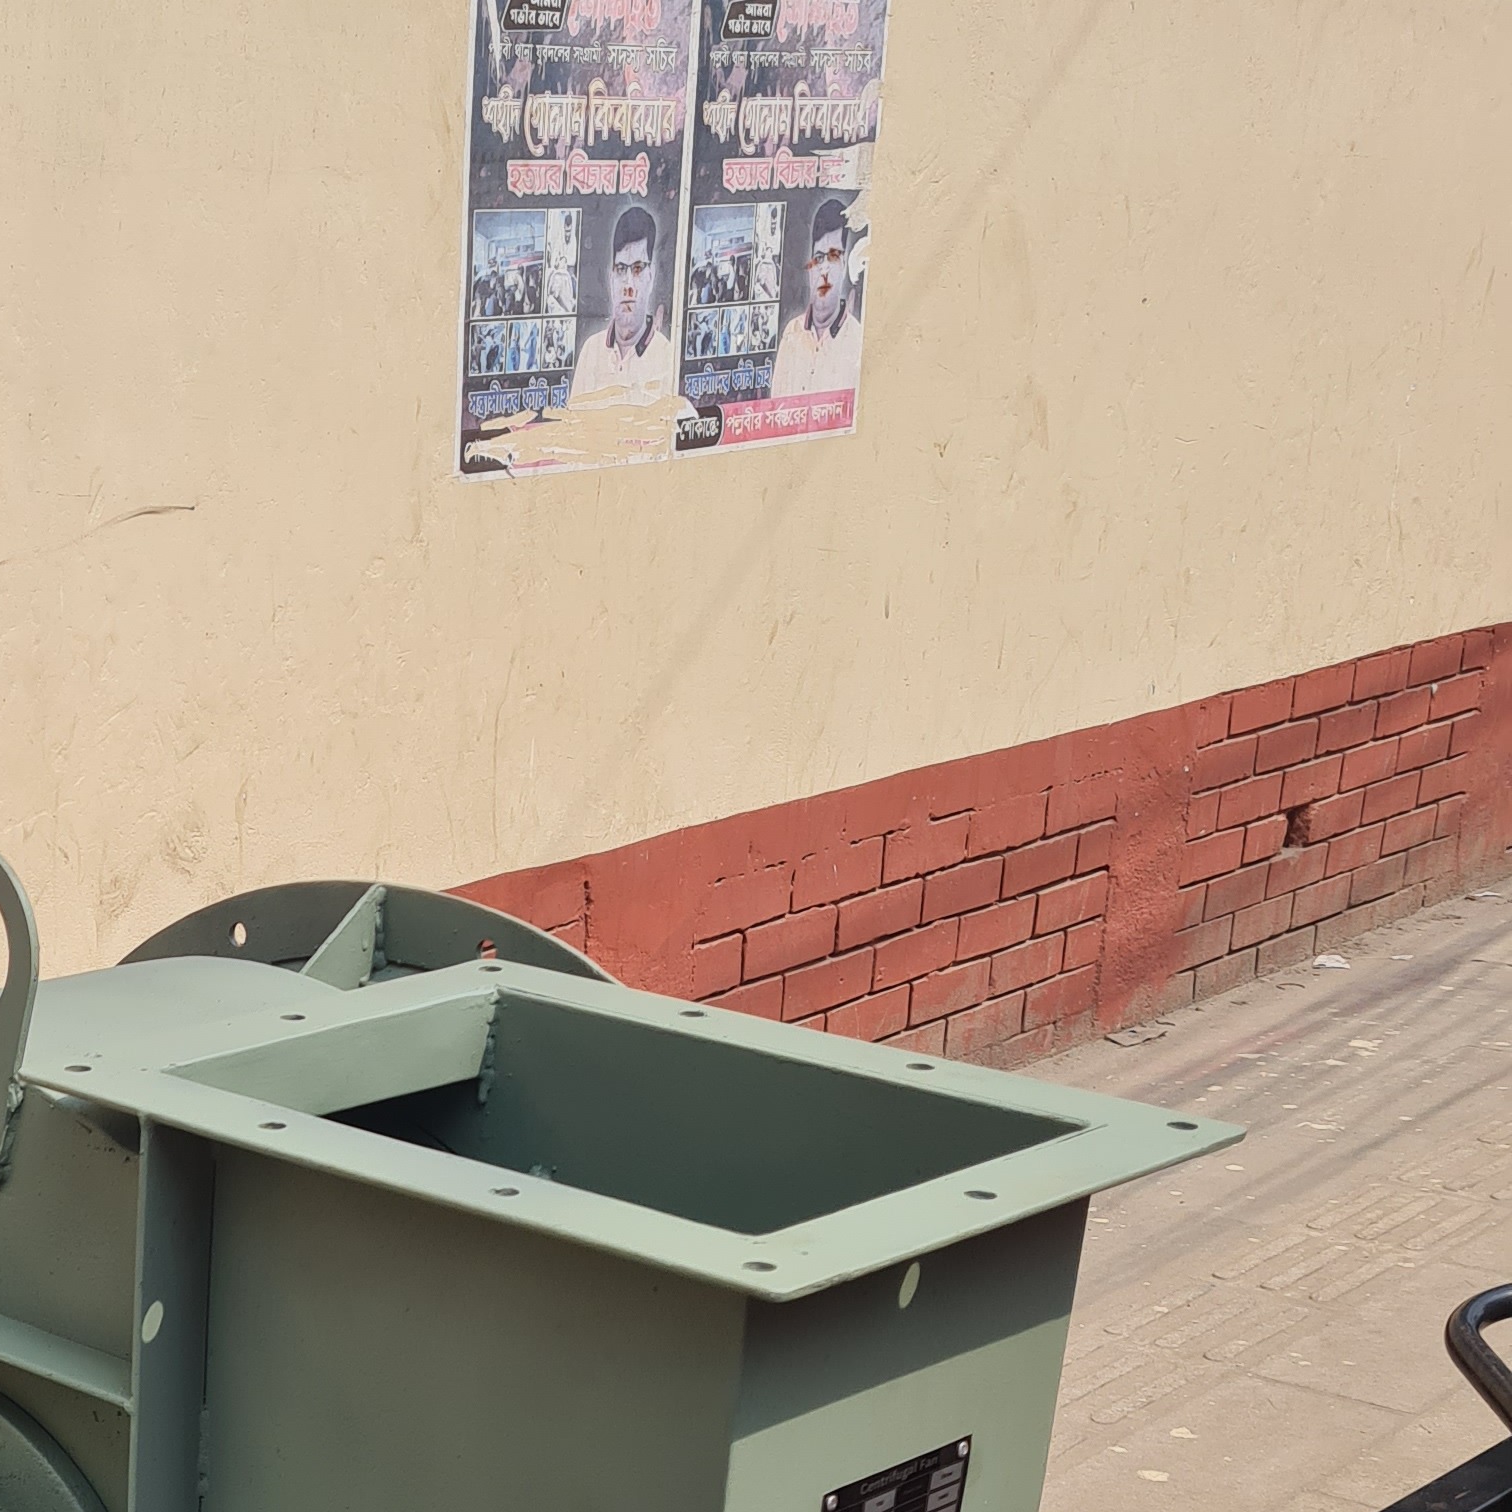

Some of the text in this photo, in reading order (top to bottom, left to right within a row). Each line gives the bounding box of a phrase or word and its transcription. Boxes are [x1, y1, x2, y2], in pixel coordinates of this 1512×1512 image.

[510, 4, 561, 27] গভীর ভাবে
[506, 148, 650, 198] হত্যার বিচার চাই
[722, 157, 773, 193] হত্যার
[773, 146, 818, 190] বিচার
[860, 1455, 939, 1496] Centrifugal Fan
